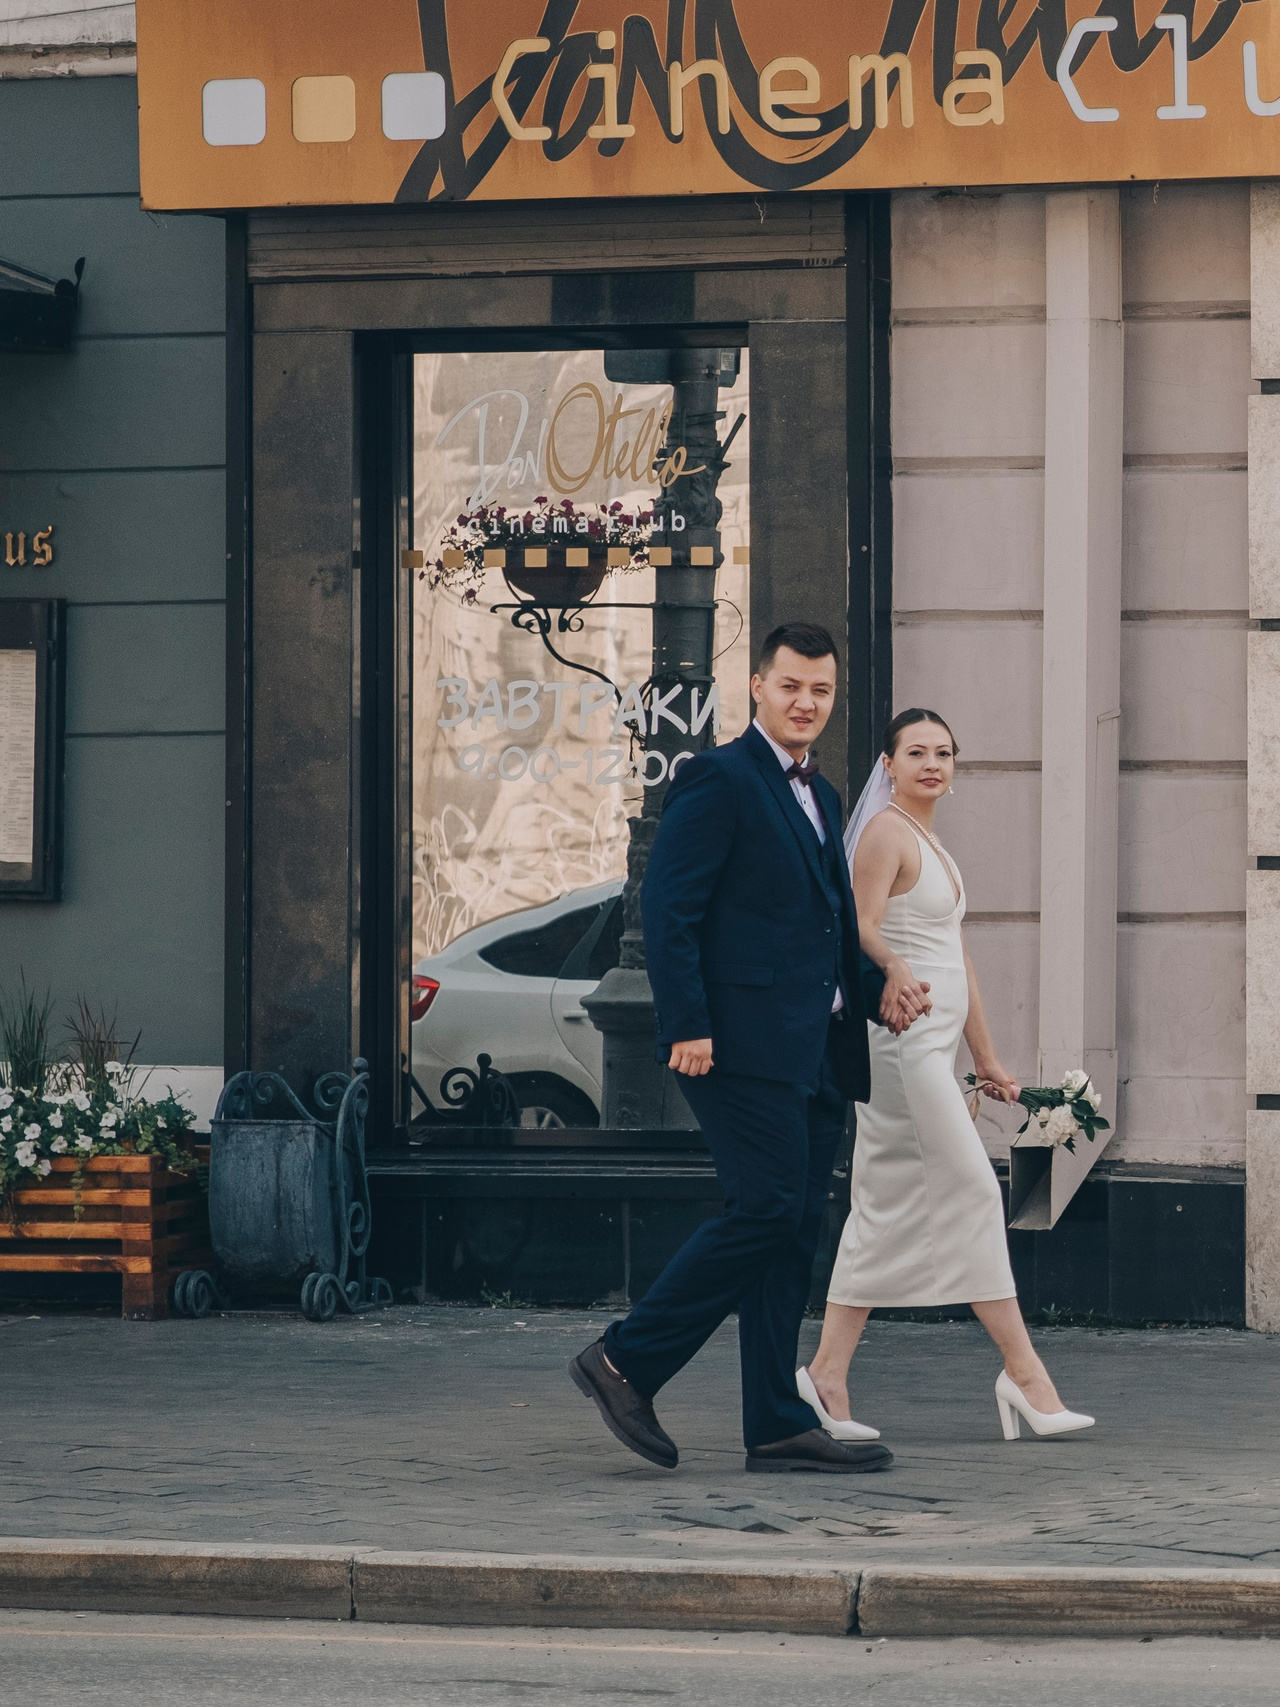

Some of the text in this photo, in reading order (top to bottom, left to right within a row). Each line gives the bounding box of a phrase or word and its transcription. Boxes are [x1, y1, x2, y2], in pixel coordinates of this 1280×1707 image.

[491, 29, 1005, 141] Cinema
[466, 509, 686, 535] cinema club
[436, 677, 722, 737] ЗАВТРАКИ
